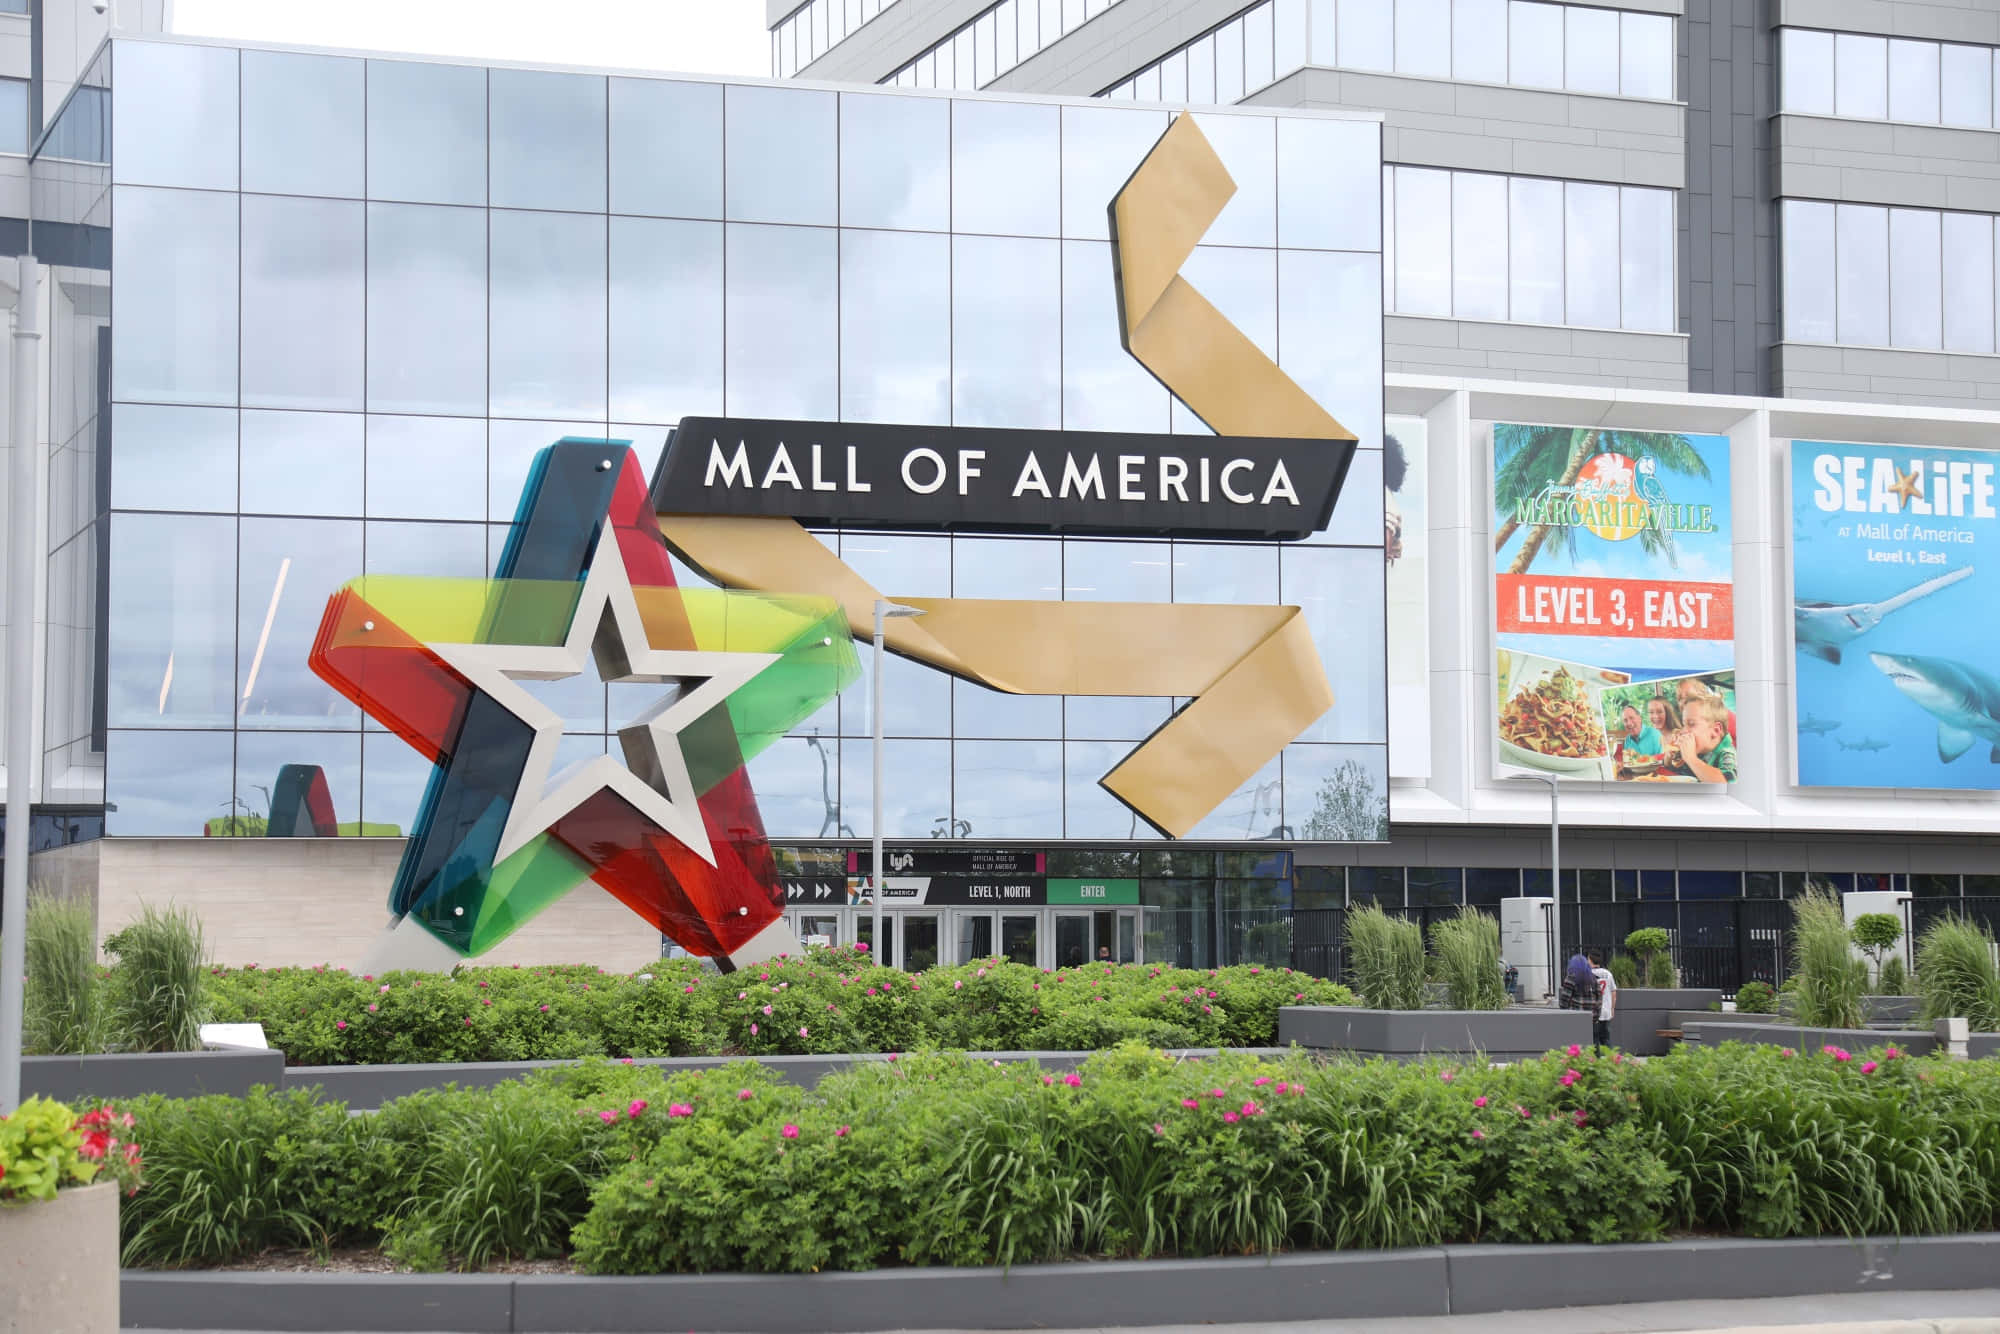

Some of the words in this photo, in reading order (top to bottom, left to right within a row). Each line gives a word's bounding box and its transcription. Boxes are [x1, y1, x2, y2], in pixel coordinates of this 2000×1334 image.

[704, 438, 872, 493] MALL
[901, 447, 986, 496] OF
[1011, 449, 1301, 506] AMERICA
[1813, 454, 1901, 514] SEA
[1515, 496, 1713, 534] MARGARITAVILLE
[1838, 527, 1851, 537] AT
[1857, 524, 1890, 541] Mall
[1893, 523, 1910, 541] of
[1912, 525, 1975, 544] America
[1868, 548, 1904, 563] Level
[1906, 551, 1916, 566] 1,
[1919, 550, 1947, 565] East
[1518, 585, 1602, 625] LEVEL
[1610, 588, 1634, 631] 3,
[1644, 590, 1713, 629] EAST
[969, 885, 993, 898] LEVEL
[995, 885, 1002, 900] 1,
[1004, 885, 1031, 898] NORTH
[1080, 885, 1106, 897] ENTER
